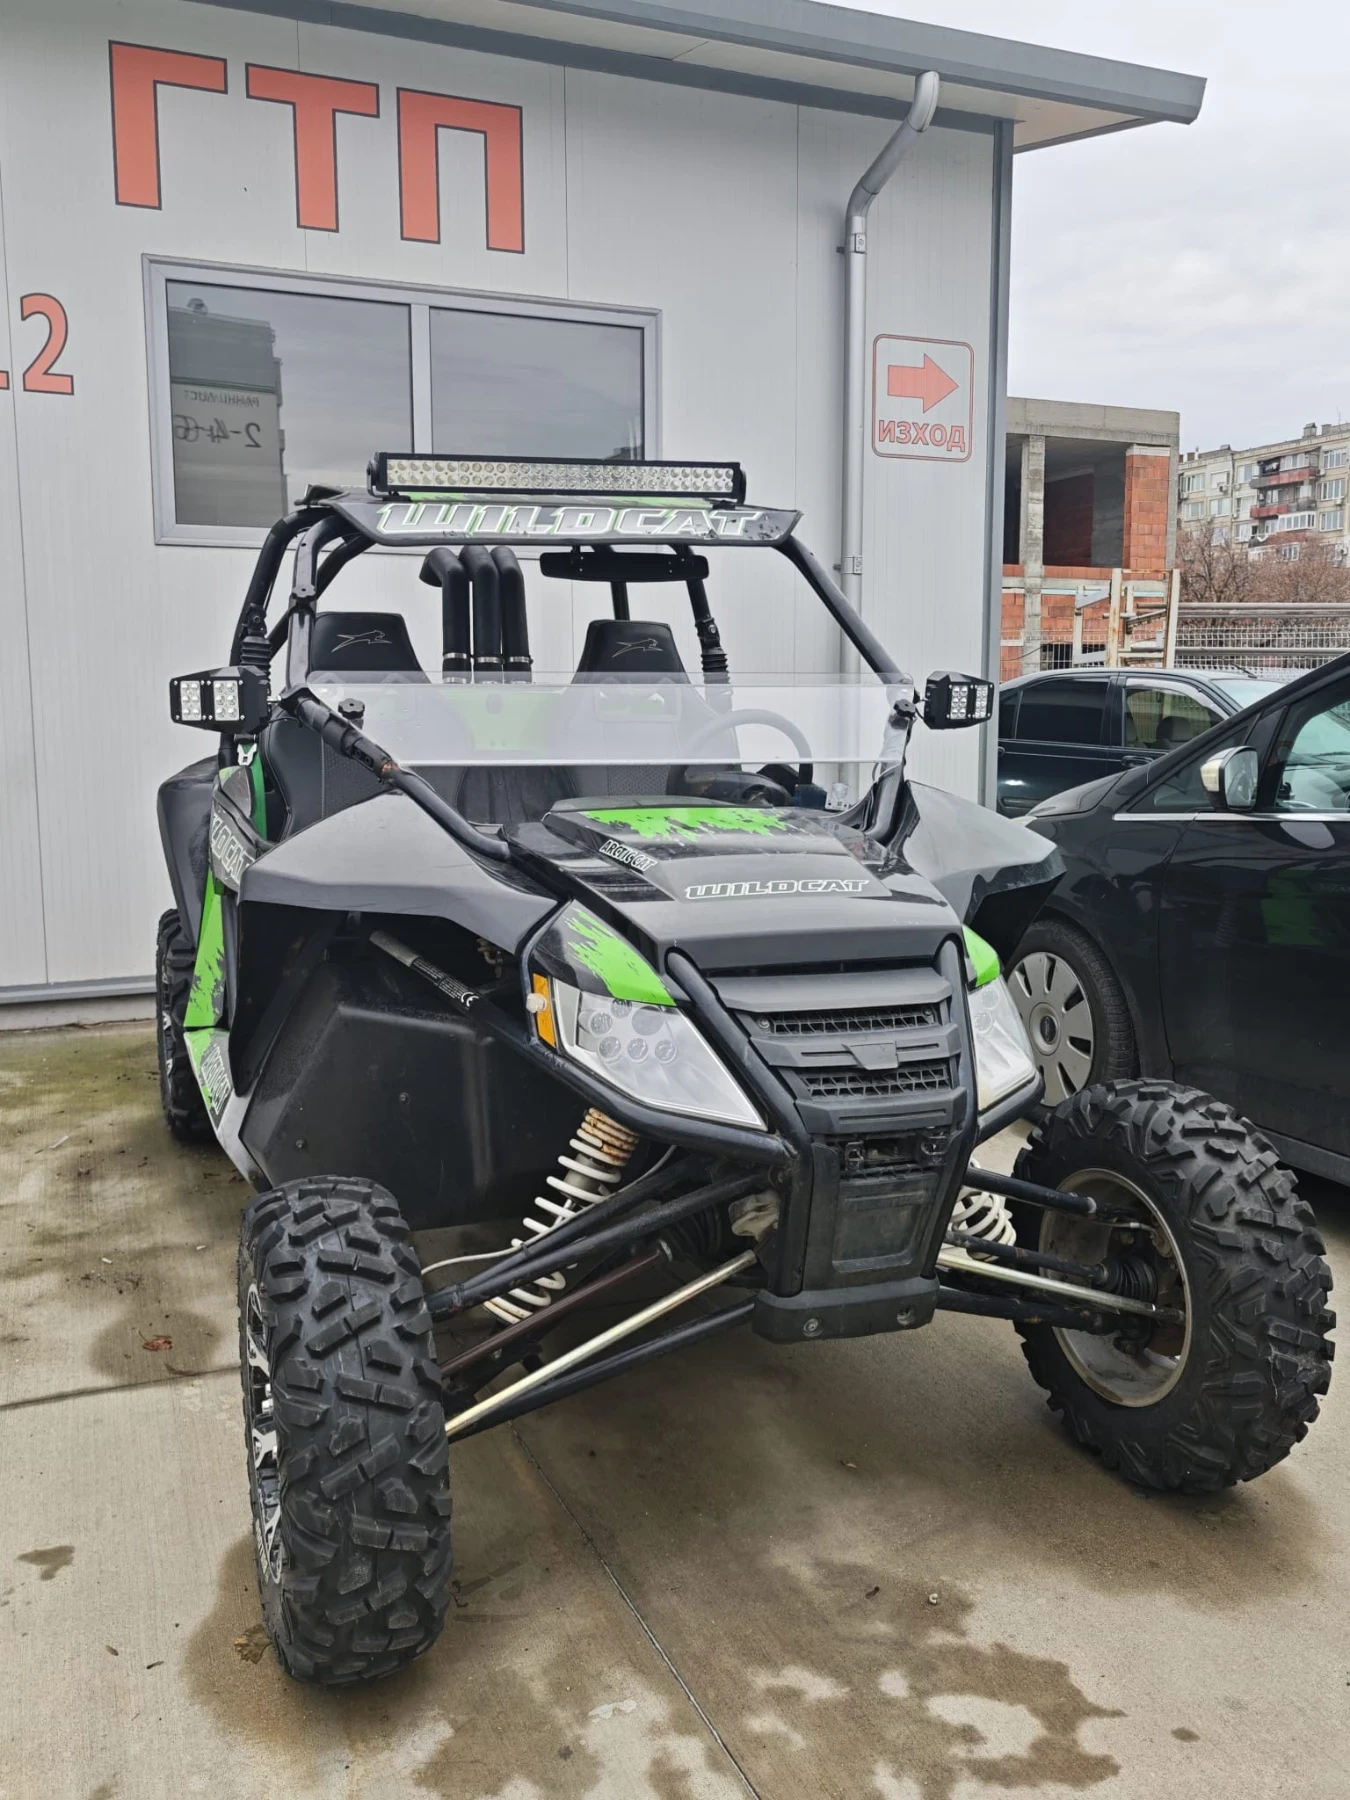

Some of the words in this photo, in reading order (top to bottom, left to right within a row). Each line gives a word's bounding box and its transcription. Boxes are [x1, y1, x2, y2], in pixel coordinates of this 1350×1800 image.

[108, 39, 525, 254] ГТП
[0, 292, 74, 396] 2
[878, 419, 966, 452] ИЗХОД
[376, 502, 764, 536] WILDCAT
[598, 839, 639, 864] ARCTIC
[630, 854, 659, 872] CAT
[684, 879, 870, 900] WILDCAT
